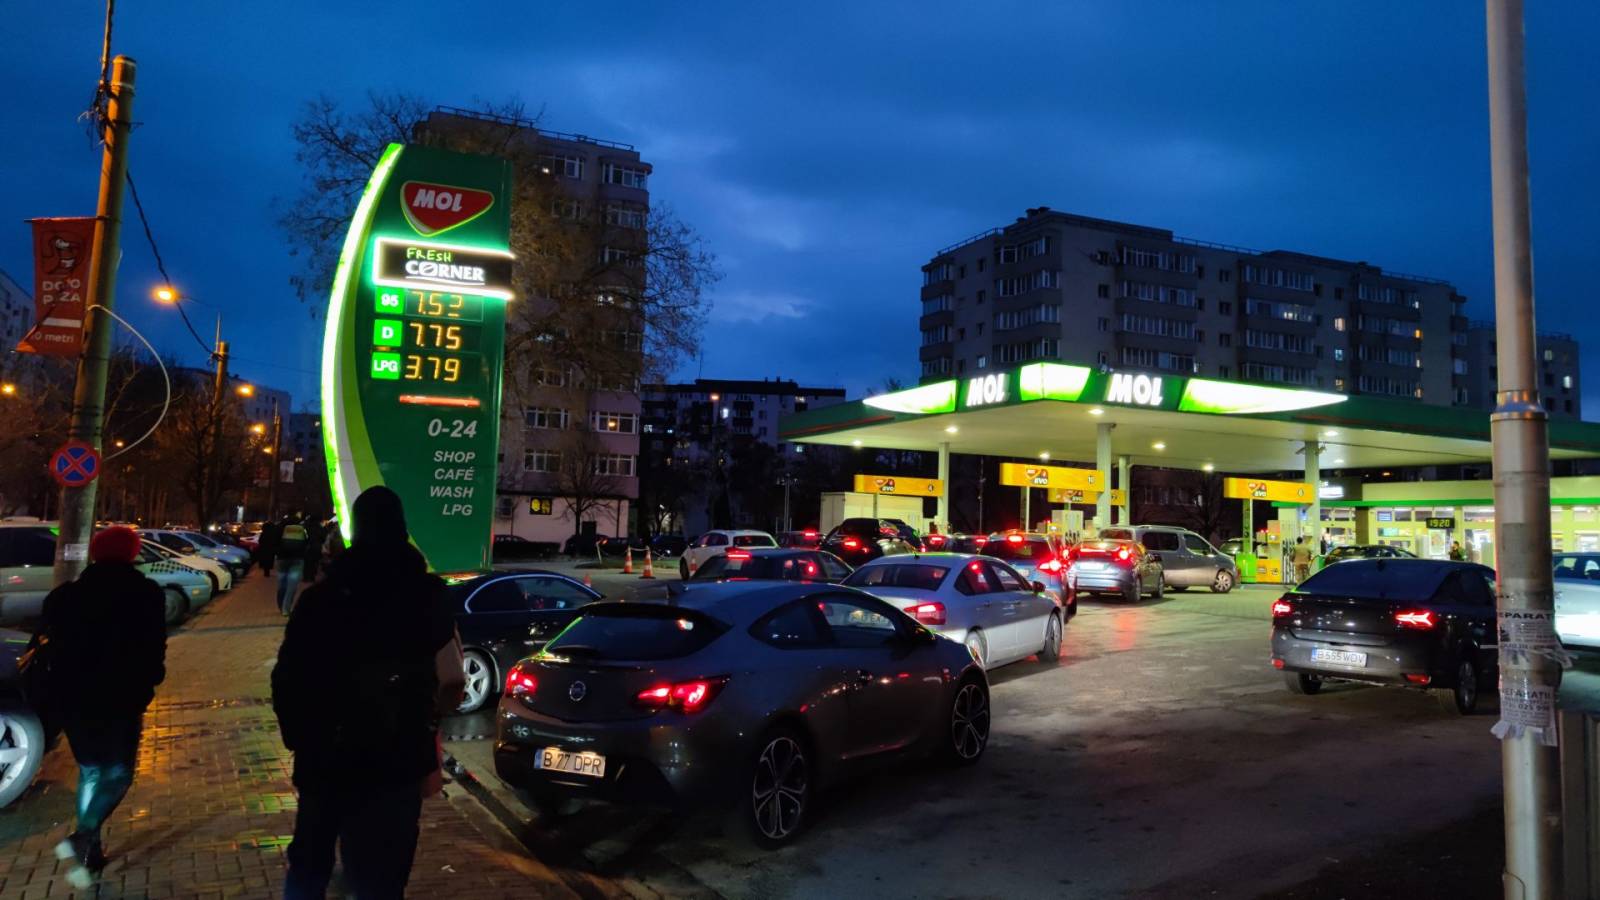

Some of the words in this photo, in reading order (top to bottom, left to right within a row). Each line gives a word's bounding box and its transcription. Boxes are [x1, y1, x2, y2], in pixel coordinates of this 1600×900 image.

[413, 189, 463, 212] MOL
[407, 248, 452, 262] FRESH
[405, 261, 485, 281] CORNER
[381, 294, 399, 306] 95
[45, 334, 74, 342] metri
[382, 326, 394, 339] D
[410, 323, 461, 349] 7.75
[373, 356, 398, 372] LPG
[405, 355, 460, 382] 3.79
[966, 373, 1006, 407] MOL
[1105, 373, 1164, 406] MOL
[428, 418, 478, 438] 0-24
[434, 451, 475, 463] SHOP
[434, 467, 474, 481] CAFÉ
[430, 486, 473, 498] WASH
[442, 504, 472, 516] LPG
[544, 752, 553, 767] B
[555, 753, 571, 770] 77
[575, 755, 601, 775] DPR
